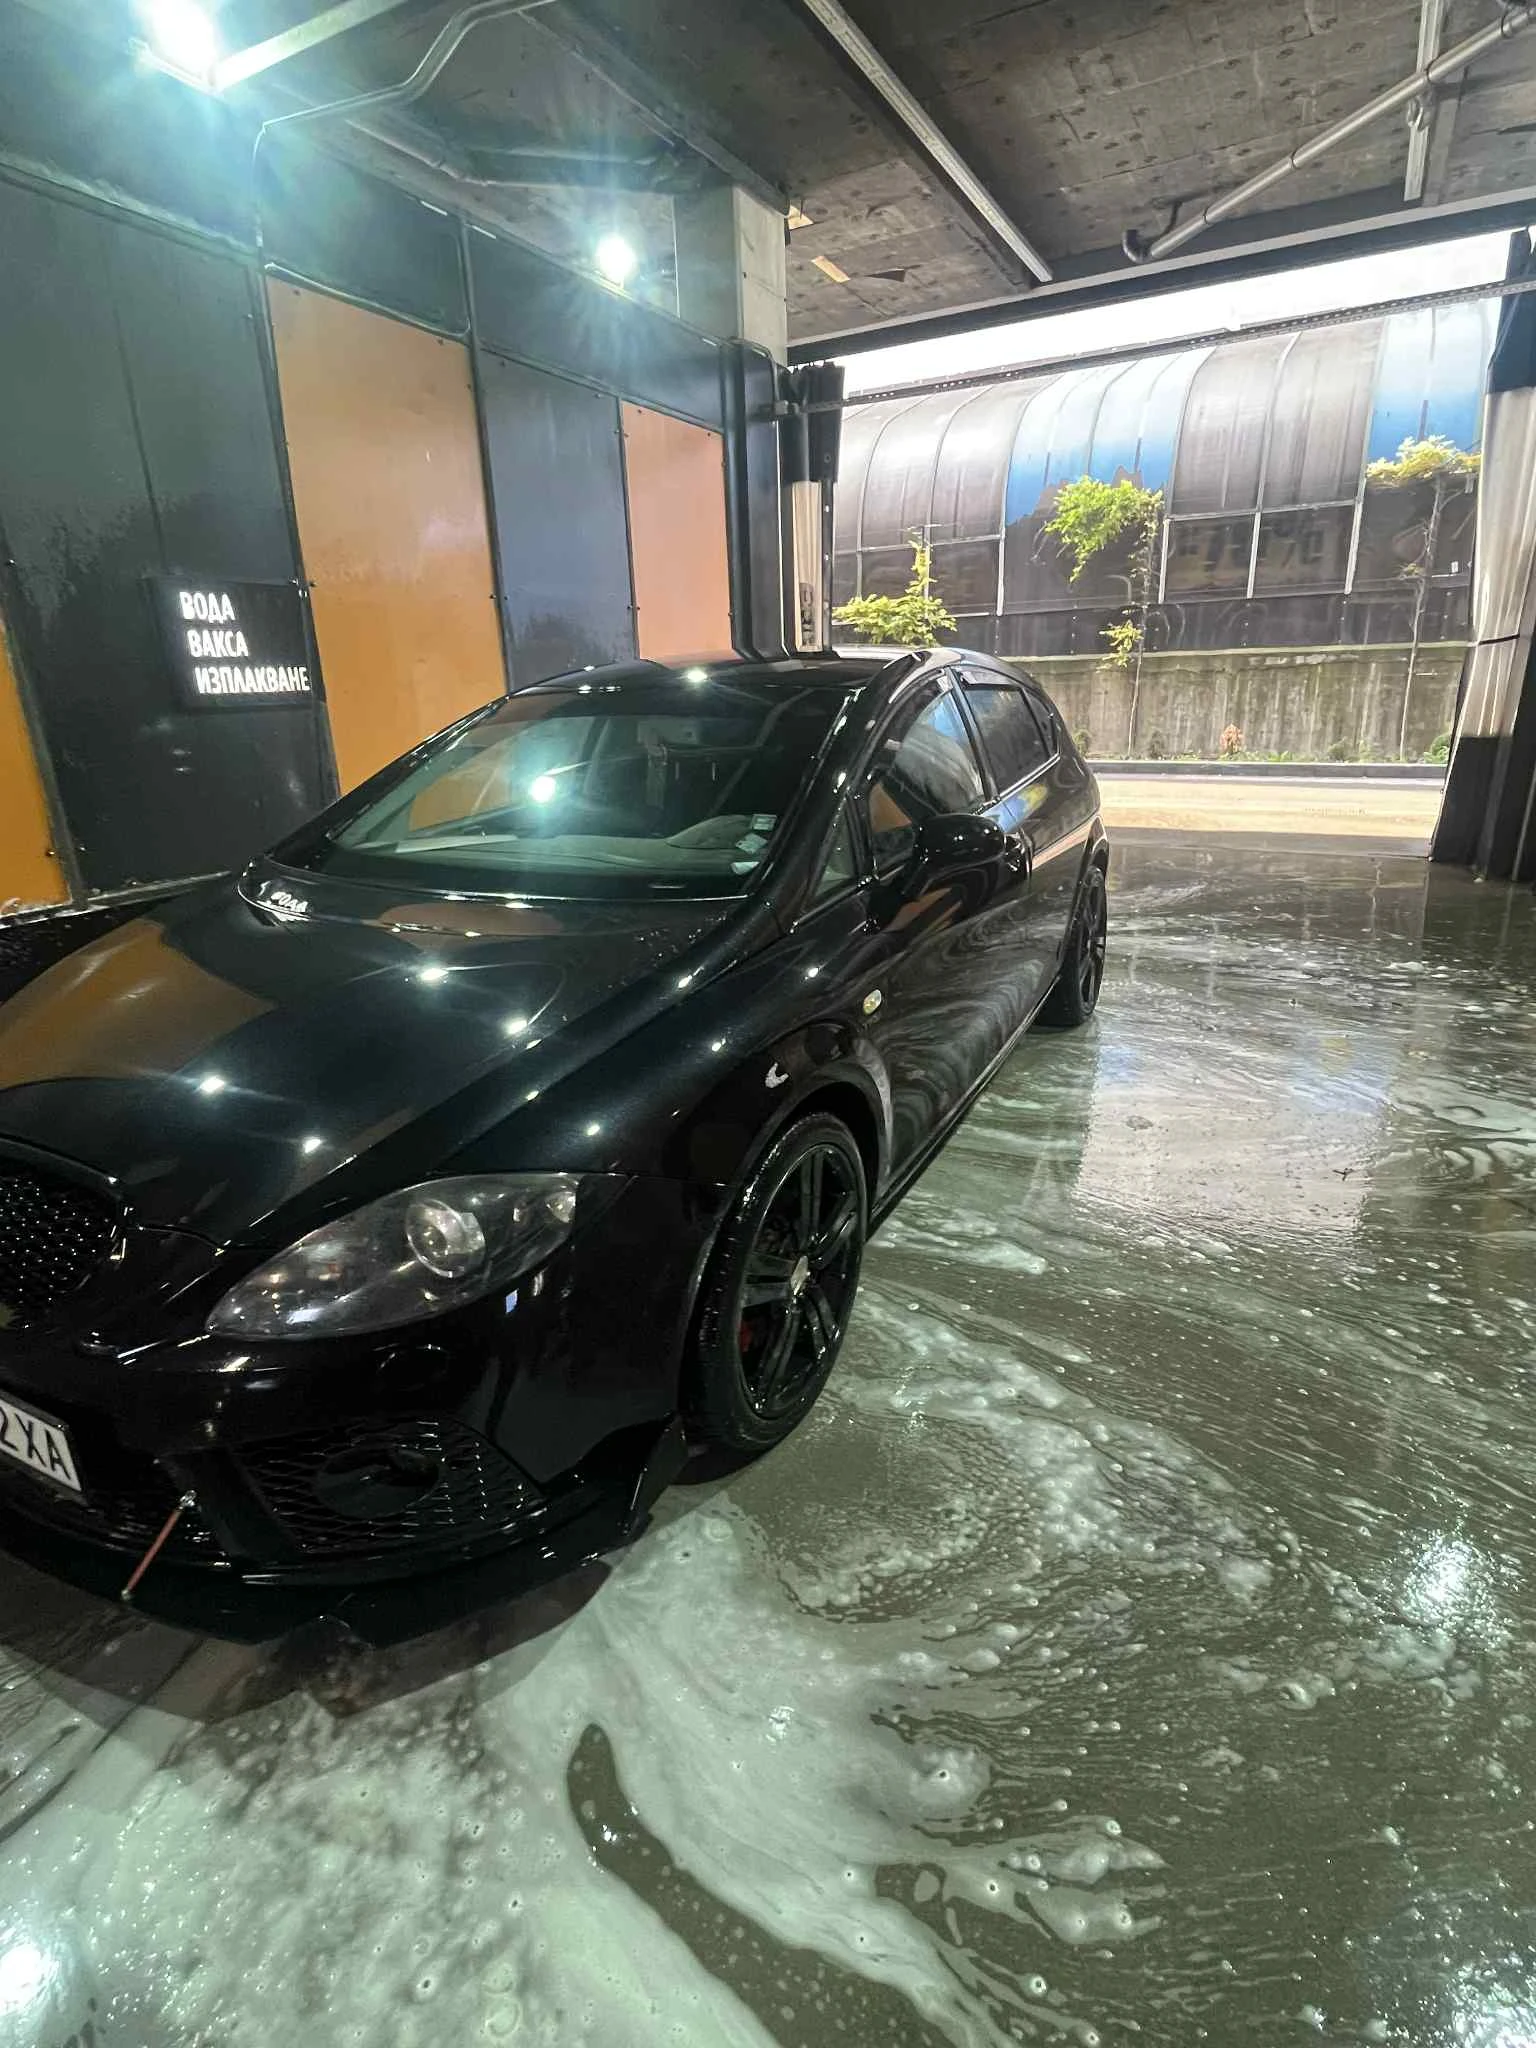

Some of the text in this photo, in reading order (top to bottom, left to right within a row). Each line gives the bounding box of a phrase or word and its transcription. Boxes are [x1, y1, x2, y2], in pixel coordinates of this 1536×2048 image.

[179, 591, 236, 624] ВОДА
[187, 629, 249, 658] ВАКСА
[194, 665, 311, 694] ИЗПЛАКВАНЕ
